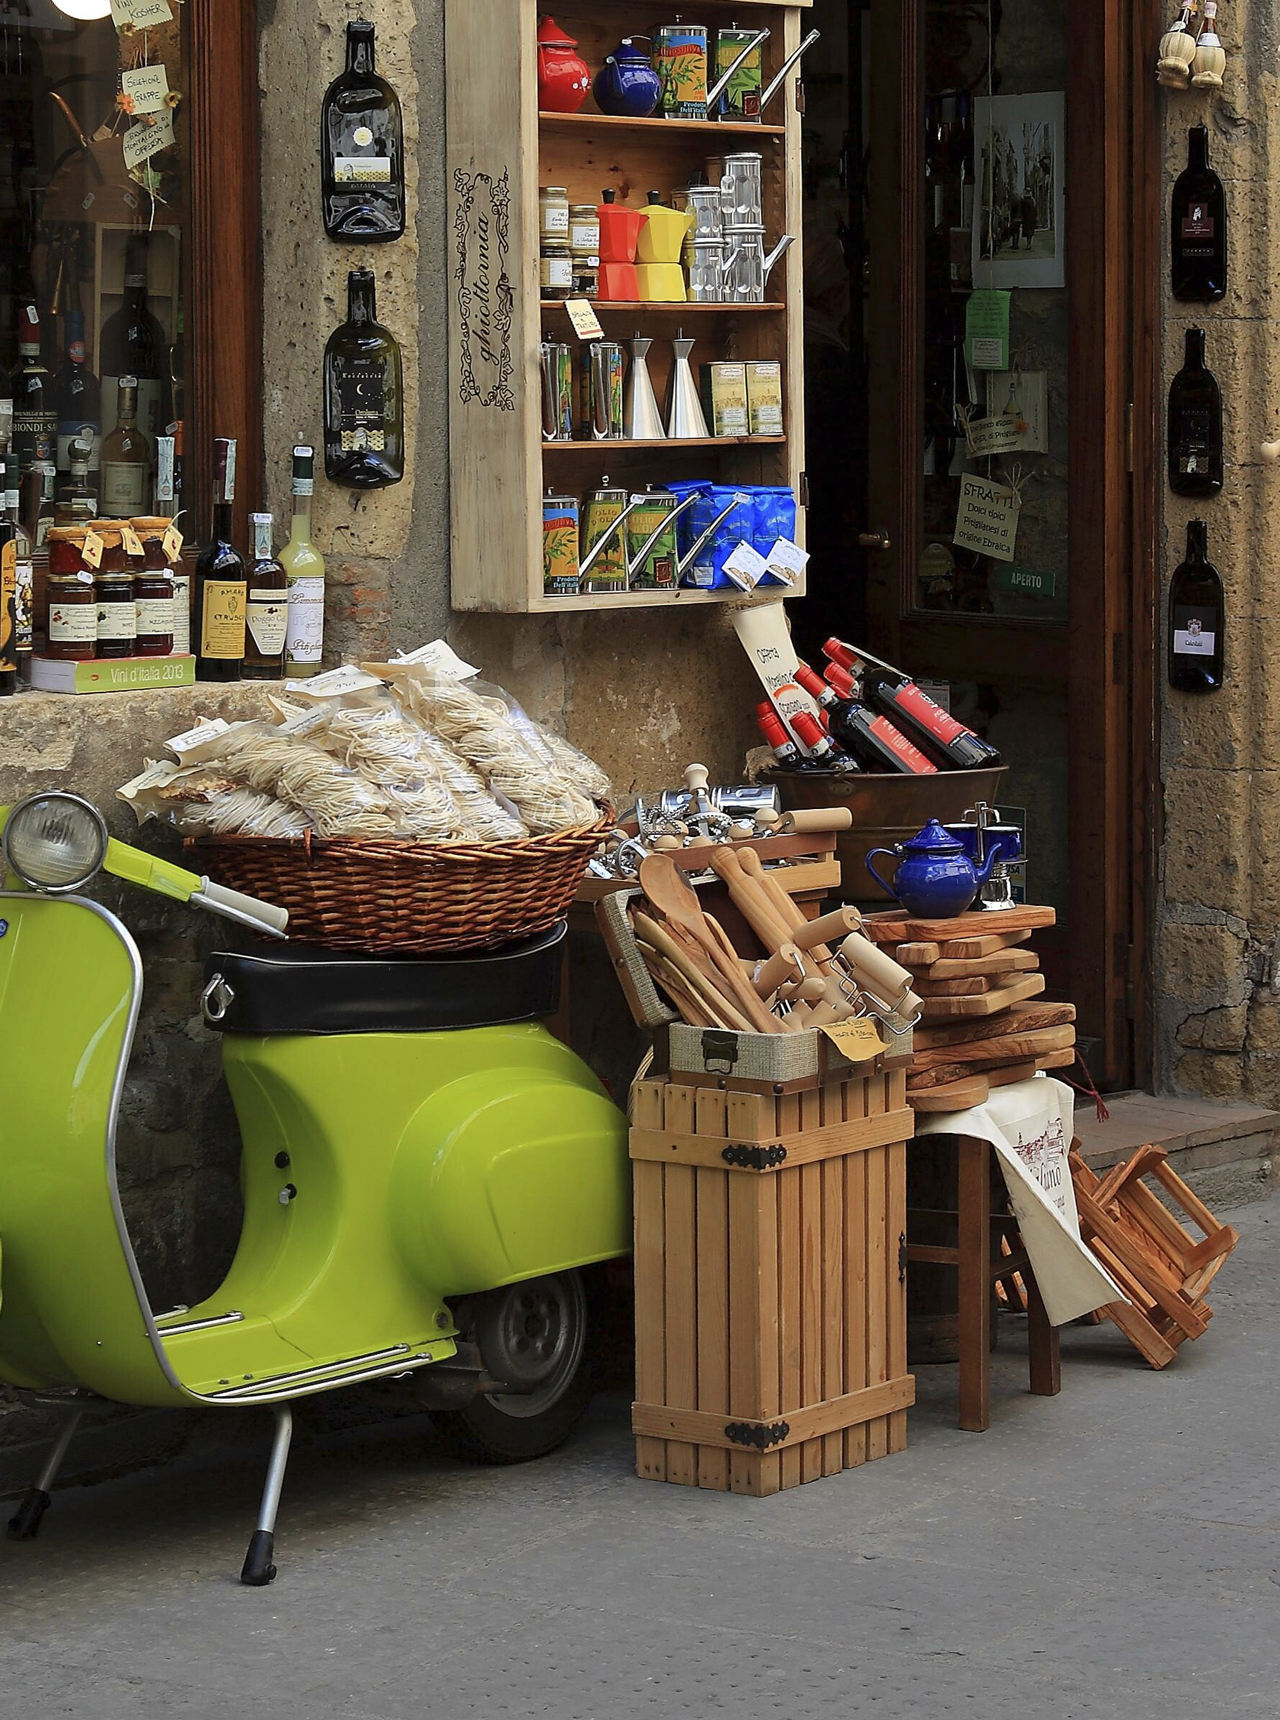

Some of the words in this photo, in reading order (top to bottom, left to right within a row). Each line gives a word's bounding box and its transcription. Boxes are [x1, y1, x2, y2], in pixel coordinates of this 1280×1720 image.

[128, 3, 165, 22] KOSHER
[133, 91, 161, 106] GRAPPE
[134, 138, 164, 156] OFFERTA
[472, 211, 499, 365] ghiottornia
[994, 429, 1020, 439] Pitiglian
[632, 515, 653, 523] OLIO
[967, 502, 986, 515] Dolci
[988, 507, 1006, 521] tipici
[963, 516, 1000, 535] Pitiglianesi
[1000, 529, 1008, 537] di
[958, 530, 981, 543] origine
[982, 537, 1011, 553] Ebraica
[1011, 572, 1042, 588] APERTO
[251, 615, 275, 624] Poggio
[757, 647, 780, 664] Offerta
[111, 668, 128, 683] Vini
[129, 666, 160, 682] d'Italia
[162, 664, 184, 680] 2013
